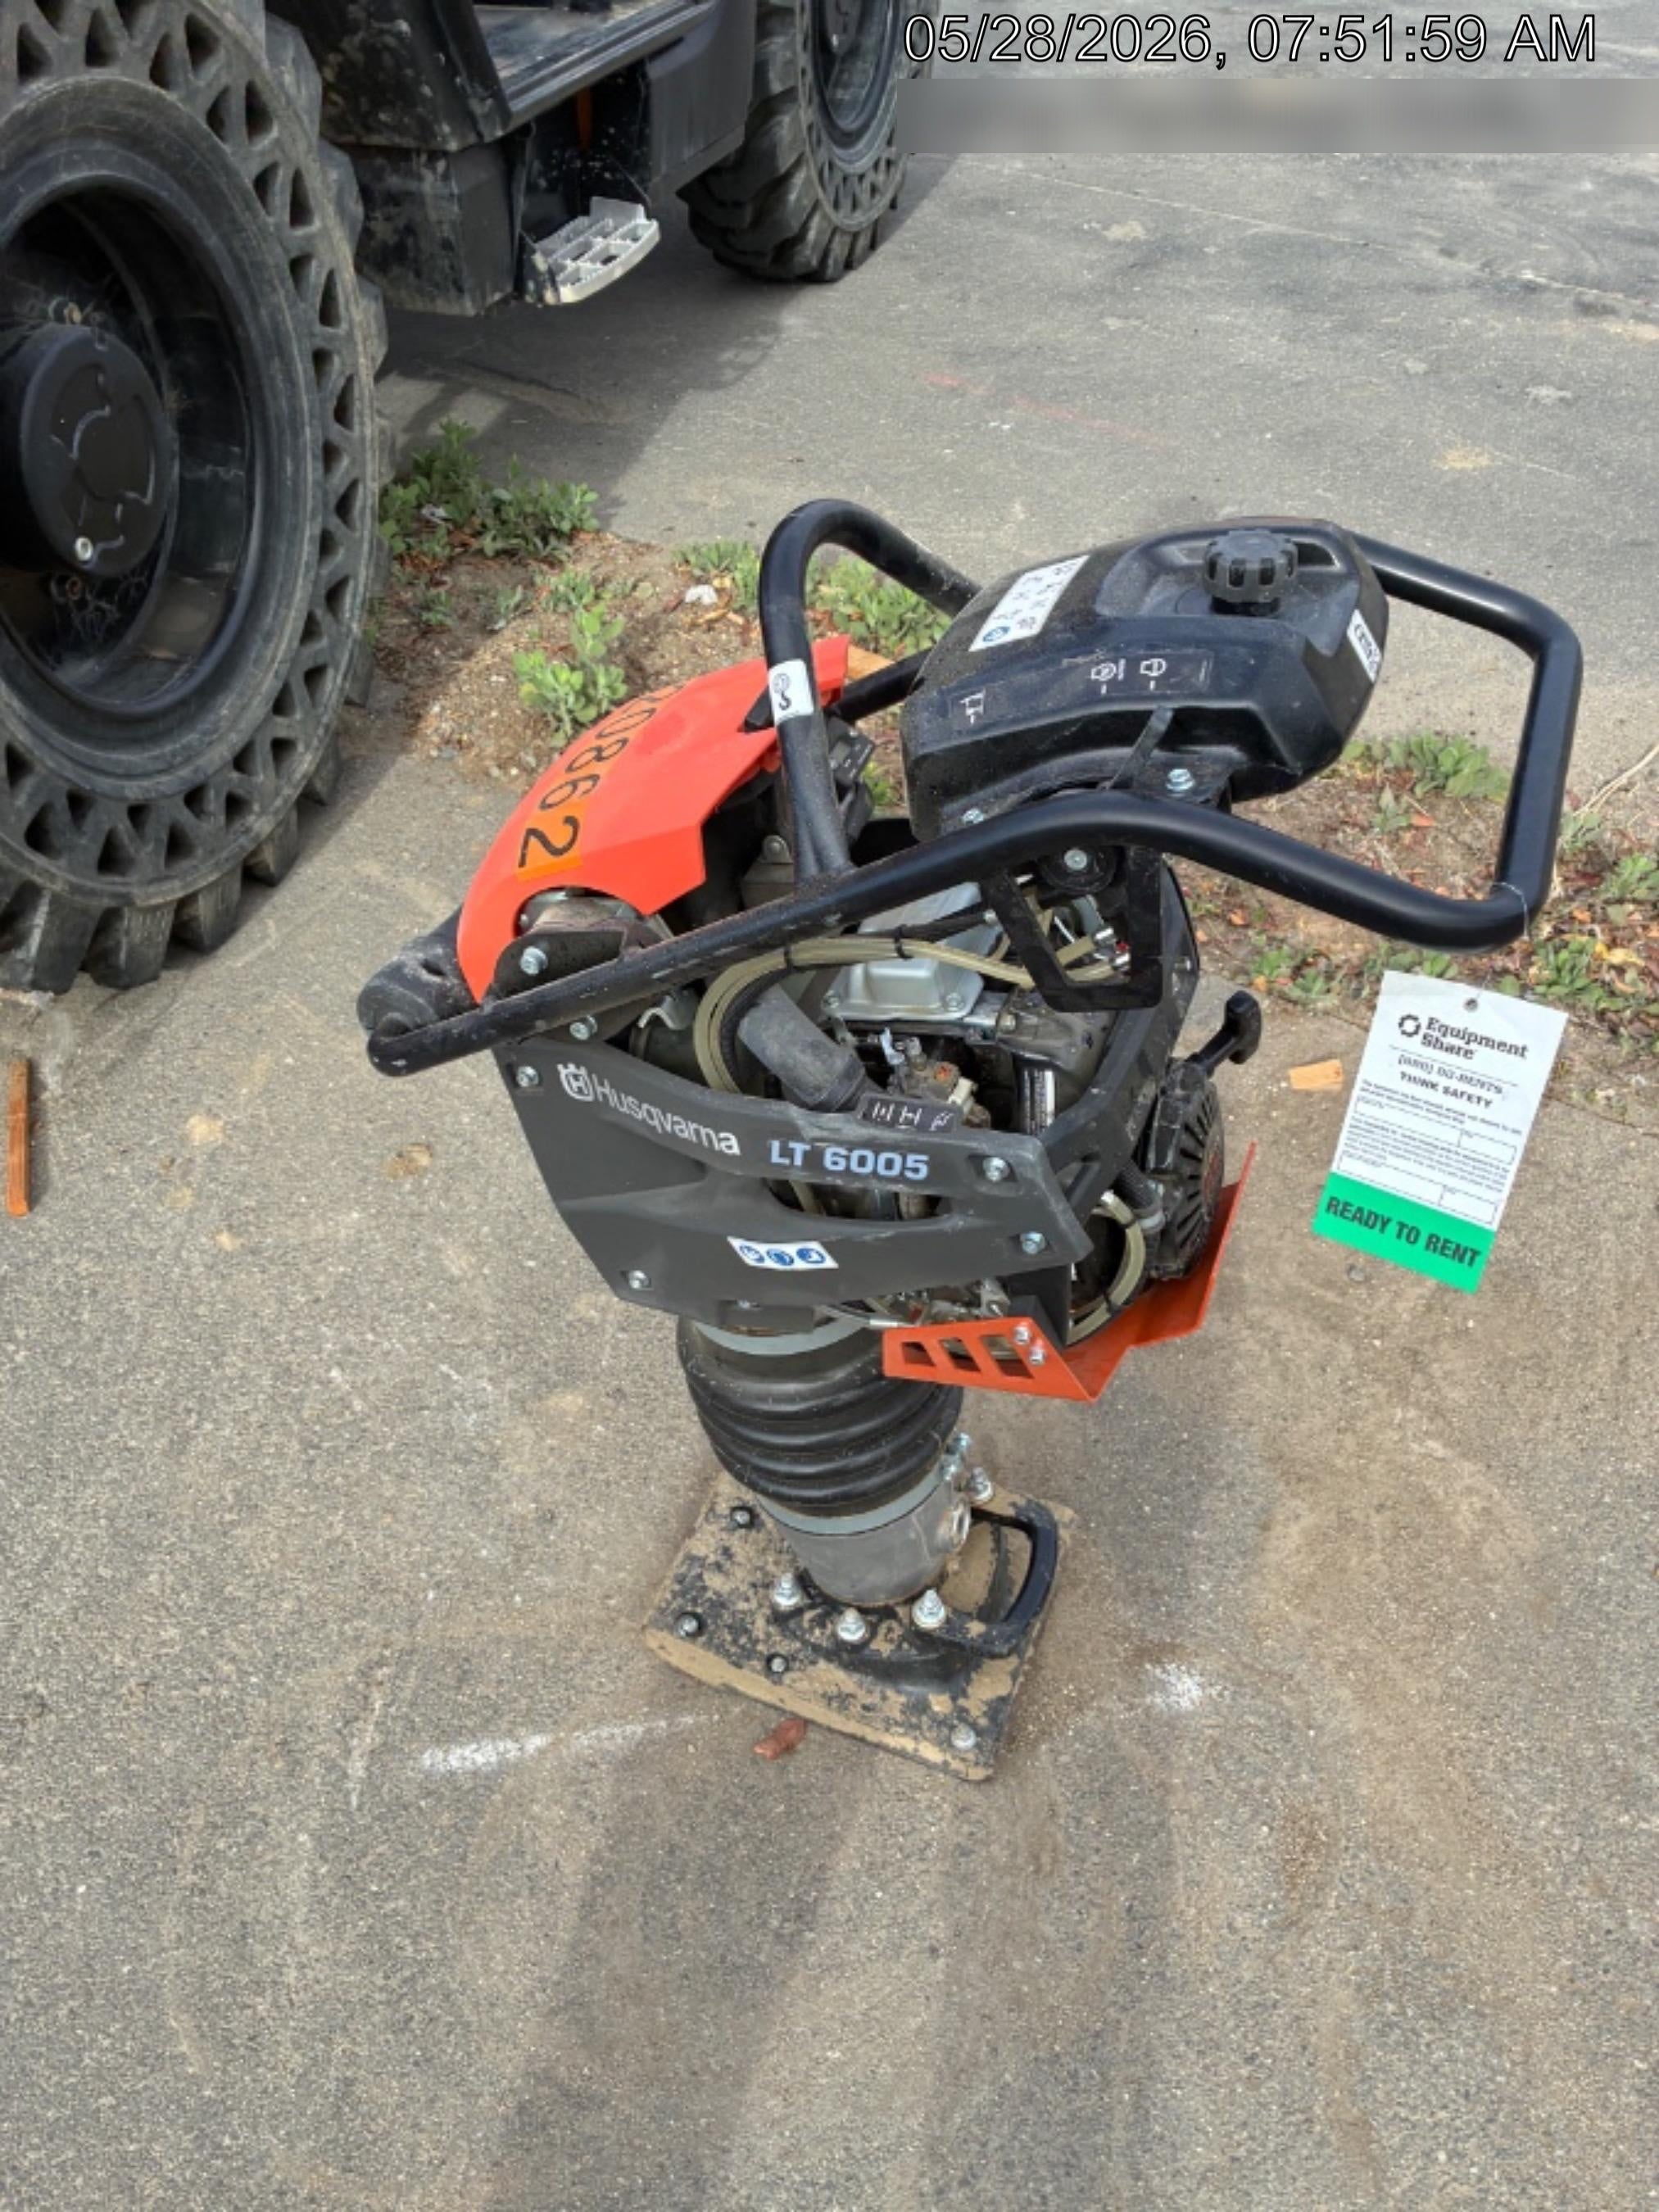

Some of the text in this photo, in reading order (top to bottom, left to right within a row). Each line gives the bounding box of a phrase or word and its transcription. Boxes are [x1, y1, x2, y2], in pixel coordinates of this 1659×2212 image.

[1421, 1032, 1475, 1060] Share
[1426, 1017, 1528, 1059] Equipment
[591, 1072, 741, 1156] Husqvarna
[1442, 1086, 1493, 1109] SAFETY
[769, 1140, 930, 1181] LT 6005
[1326, 1196, 1482, 1268] READY TO RENT
